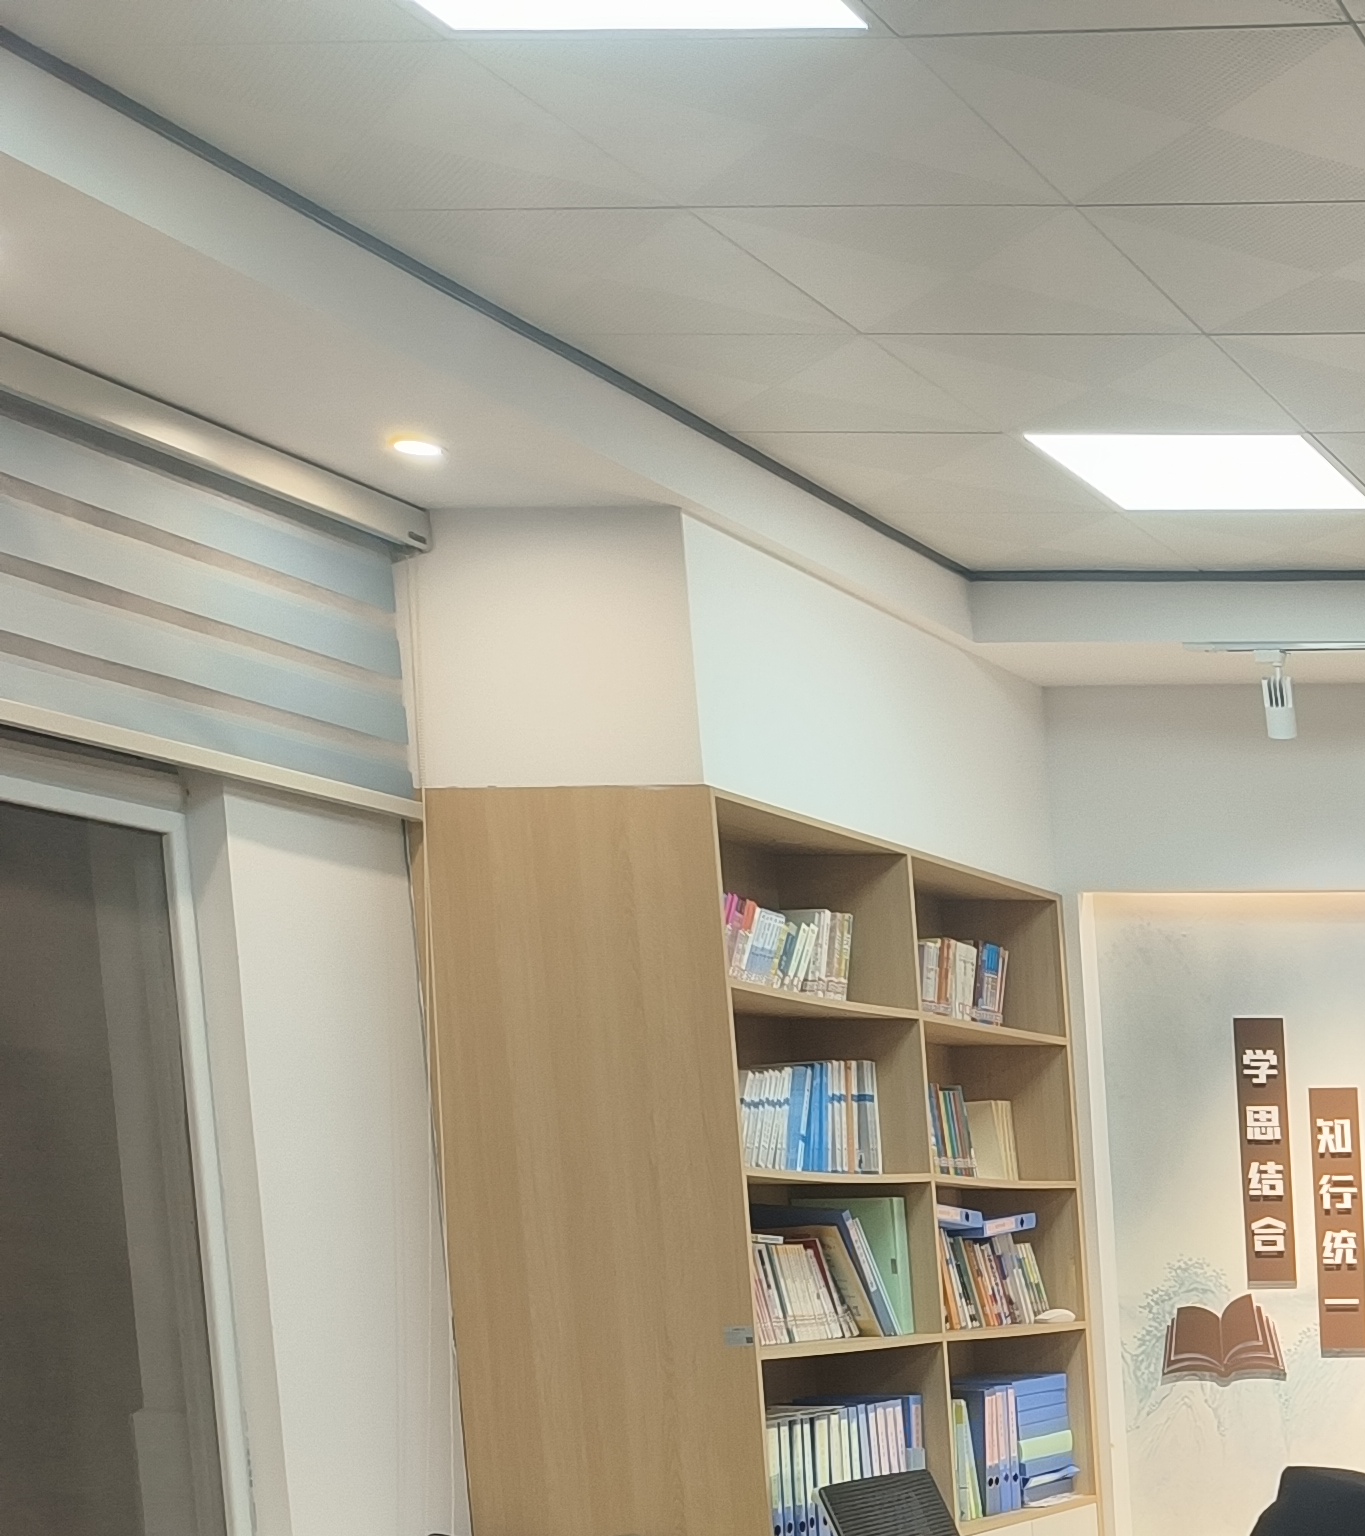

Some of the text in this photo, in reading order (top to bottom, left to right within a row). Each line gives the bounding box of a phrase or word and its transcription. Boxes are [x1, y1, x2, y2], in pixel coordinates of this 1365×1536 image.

[1241, 1048, 1287, 1255] 学思结合
[1316, 1117, 1360, 1308] 知行统一
